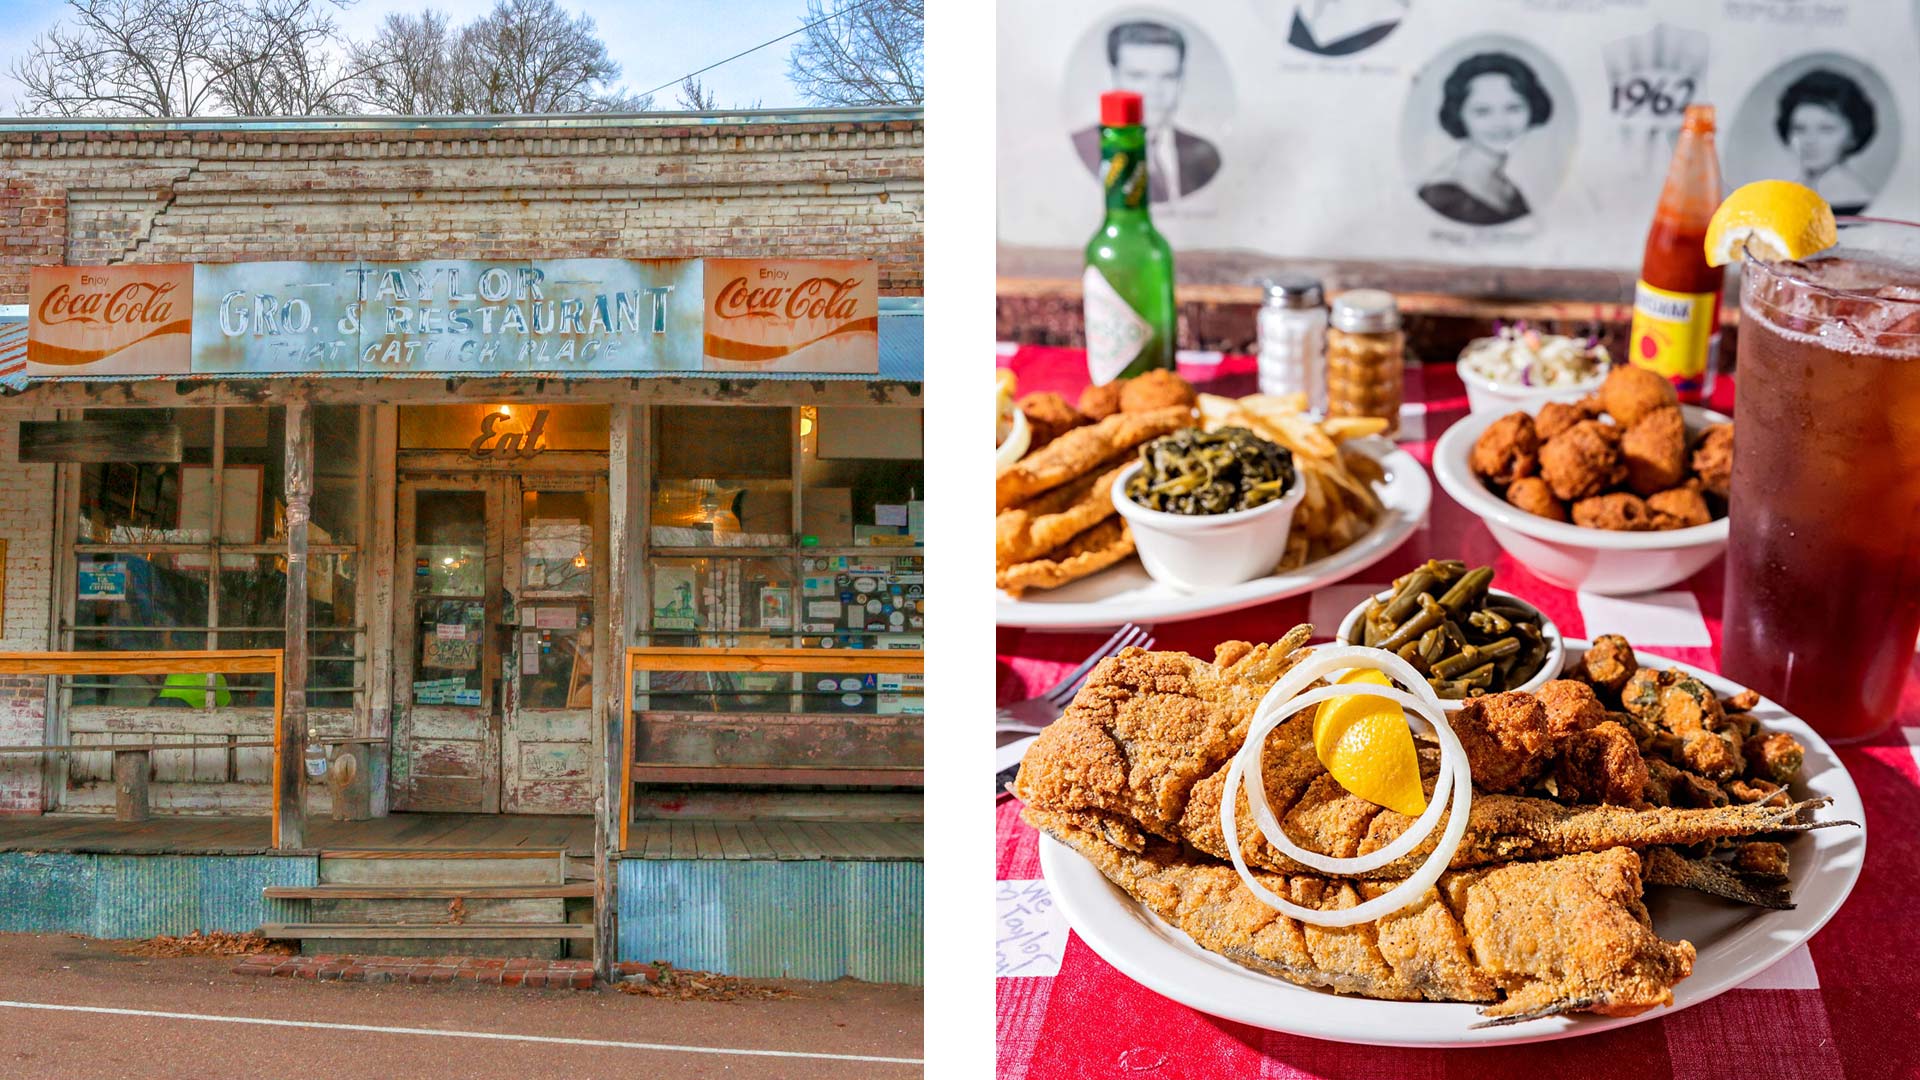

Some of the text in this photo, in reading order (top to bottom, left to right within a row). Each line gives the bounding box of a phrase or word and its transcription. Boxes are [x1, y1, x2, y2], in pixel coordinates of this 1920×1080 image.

[1611, 78, 1695, 117] 1962
[81, 275, 110, 286] Enjoy
[345, 267, 545, 302] TAYLOR
[760, 268, 790, 280] Enjoy
[38, 281, 180, 326] Coca-Cola
[219, 285, 676, 337] GRO. & RESTAURANT
[714, 277, 864, 320] Coca-Cola
[517, 339, 622, 363] PLACE
[468, 409, 550, 461] Eat
[1022, 881, 1052, 913] We
[996, 903, 1058, 974] Taylor
